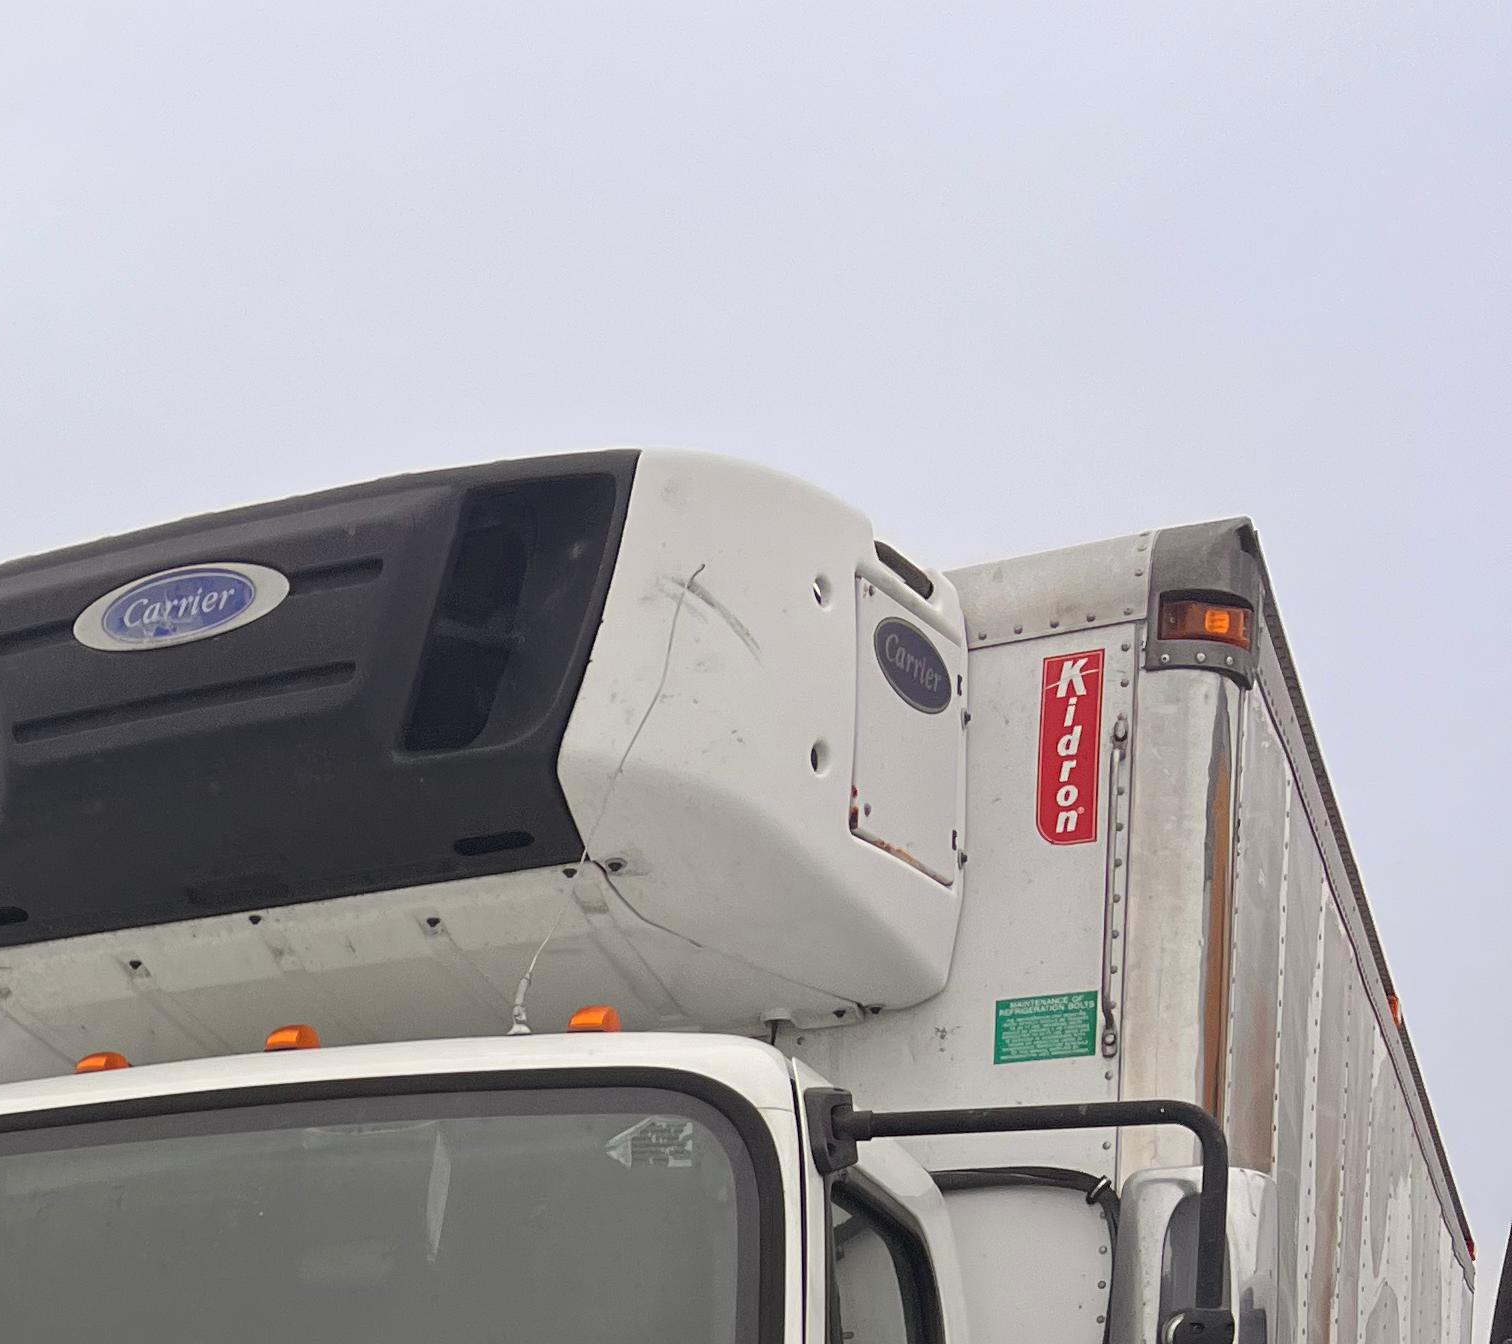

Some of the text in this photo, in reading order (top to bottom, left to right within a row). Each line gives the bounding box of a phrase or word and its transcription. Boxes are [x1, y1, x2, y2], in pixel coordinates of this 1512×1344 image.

[123, 586, 236, 628] Carrier
[885, 633, 942, 693] Carrier
[1055, 657, 1088, 833] Kidron
